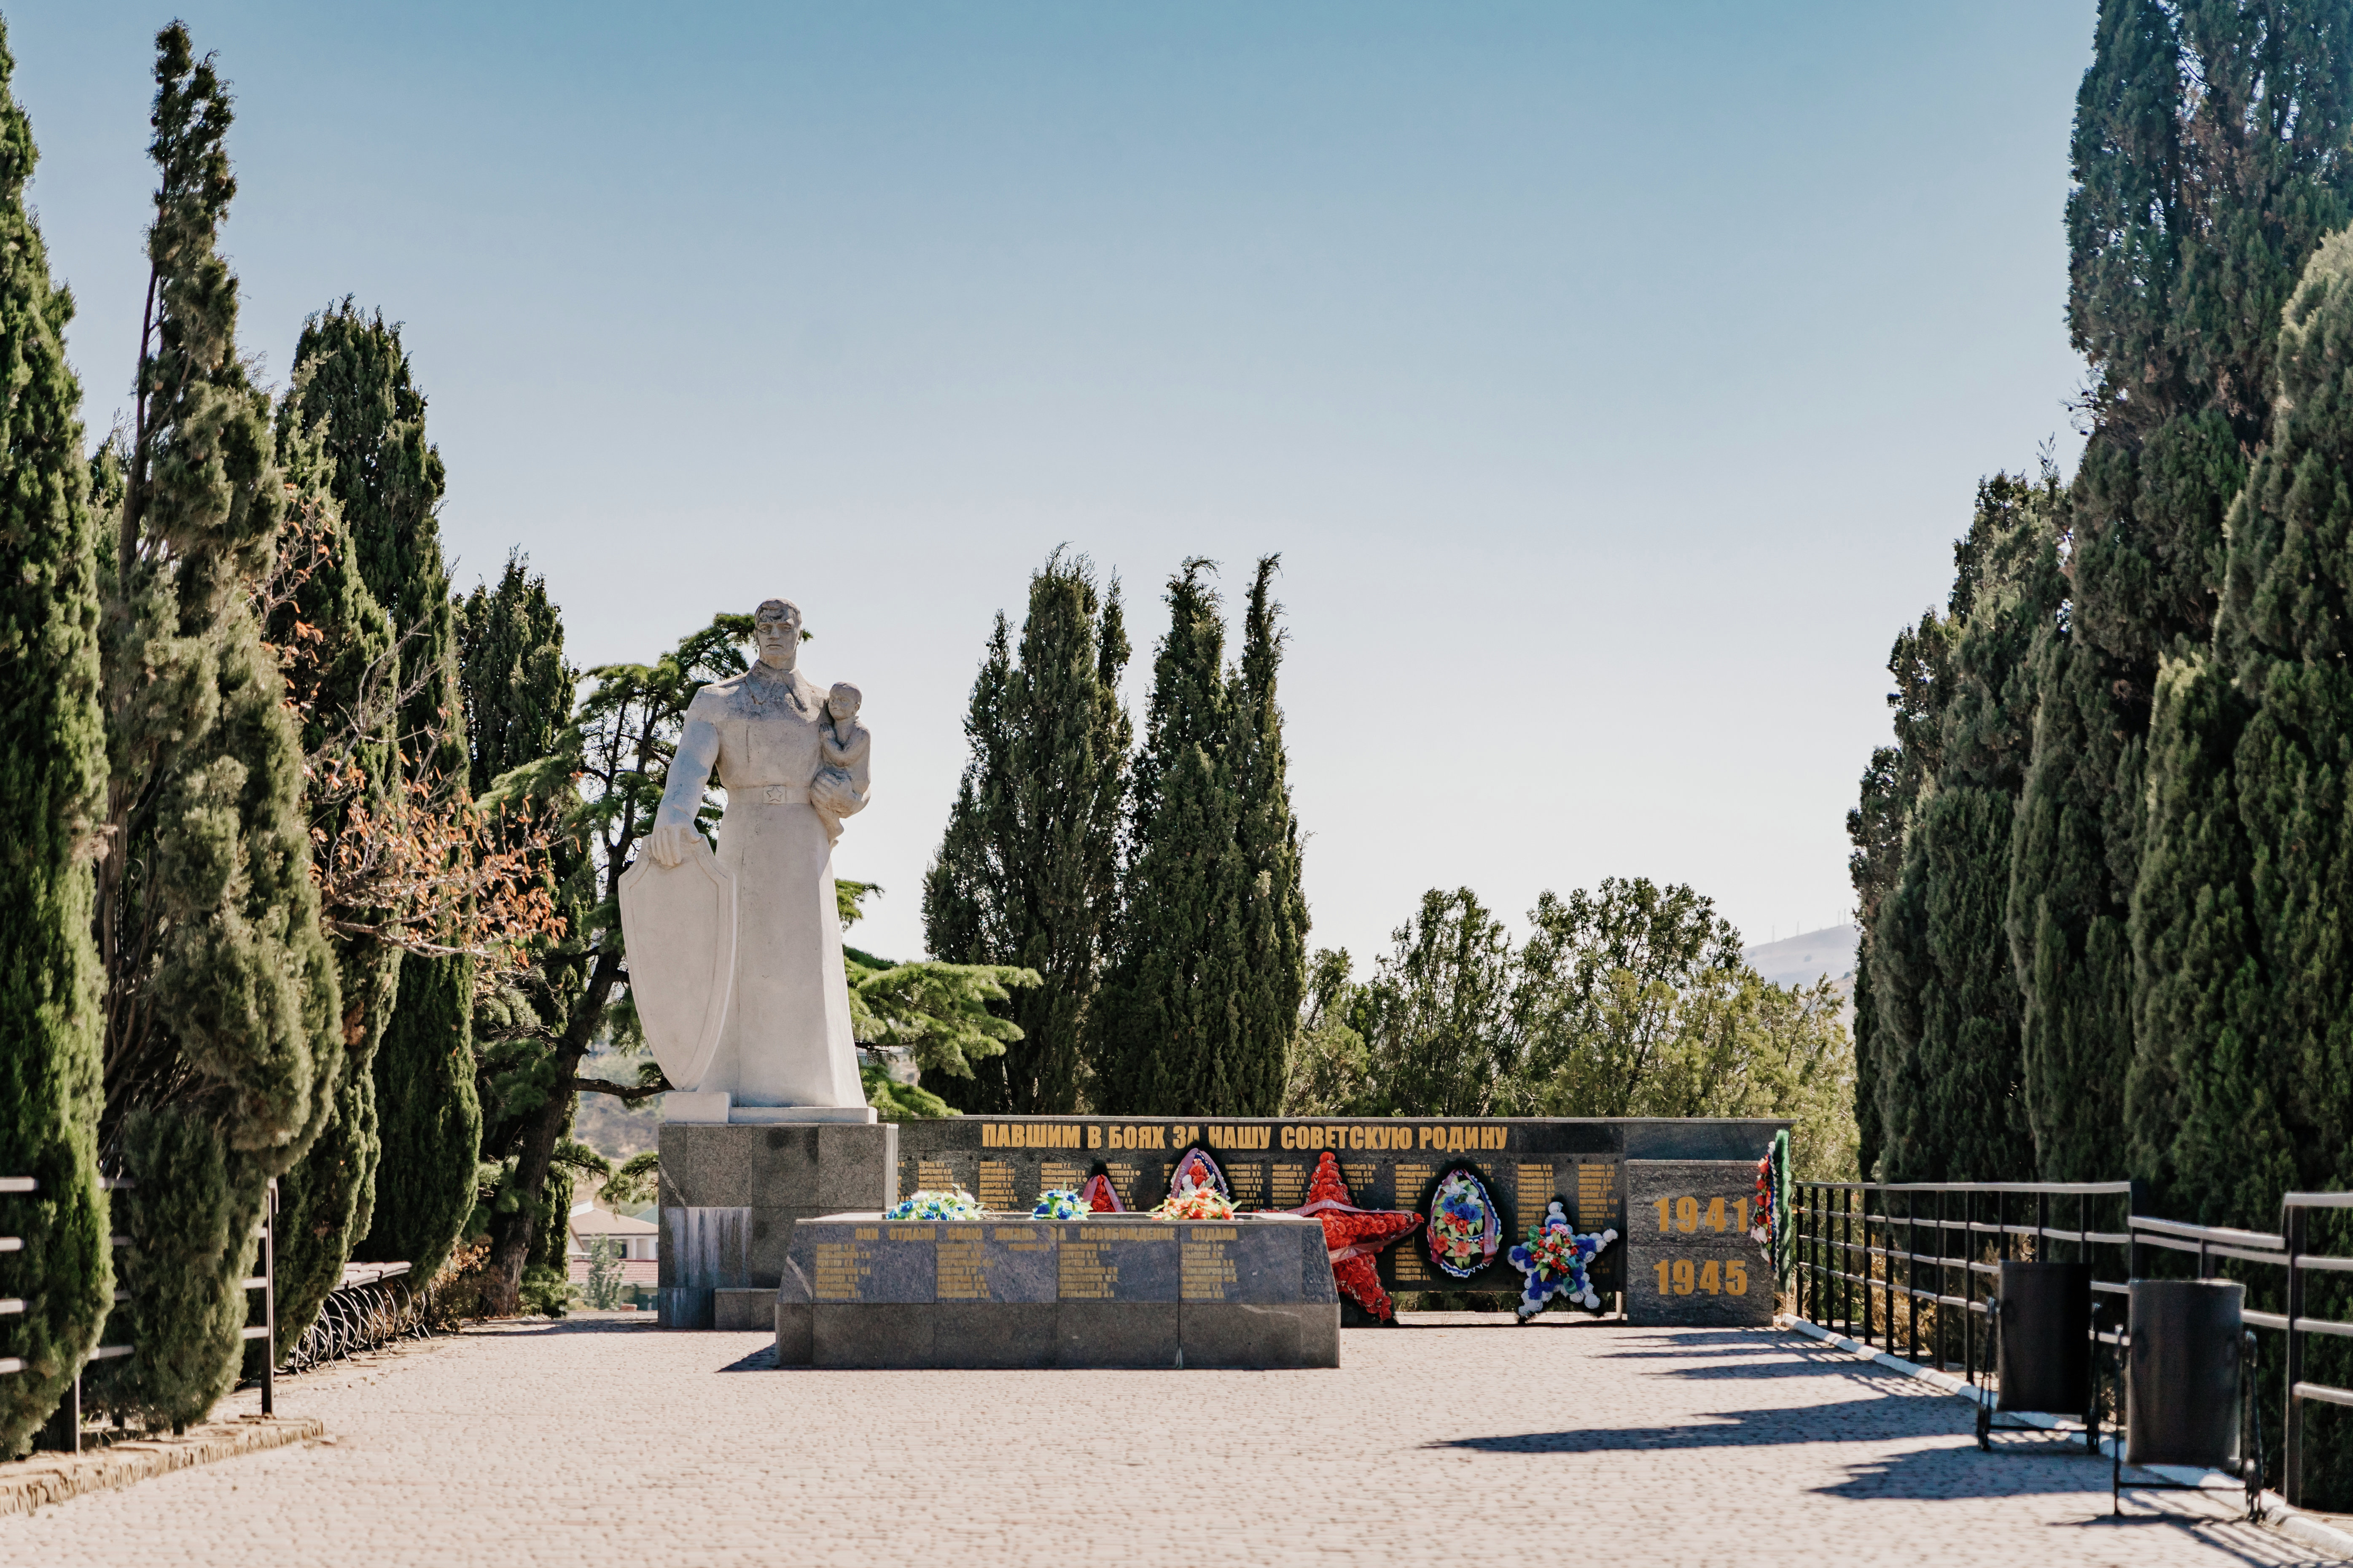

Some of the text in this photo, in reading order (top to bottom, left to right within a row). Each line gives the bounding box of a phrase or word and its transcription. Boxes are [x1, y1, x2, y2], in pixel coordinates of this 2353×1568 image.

[982, 1124, 1508, 1153] ПАВШИМ В БОЯХ ЗА НАШУ СОВЕТСКУЮ РОДИНУ
[1654, 1196, 1748, 1232] 1941
[855, 1227, 1237, 1242] ОНИ ОТДАЛИ СВОЮ ЖИЗНЬ ЗА ОСВОБОЖДЕНИЕ СУДАКА
[1653, 1259, 1748, 1296] 1945
